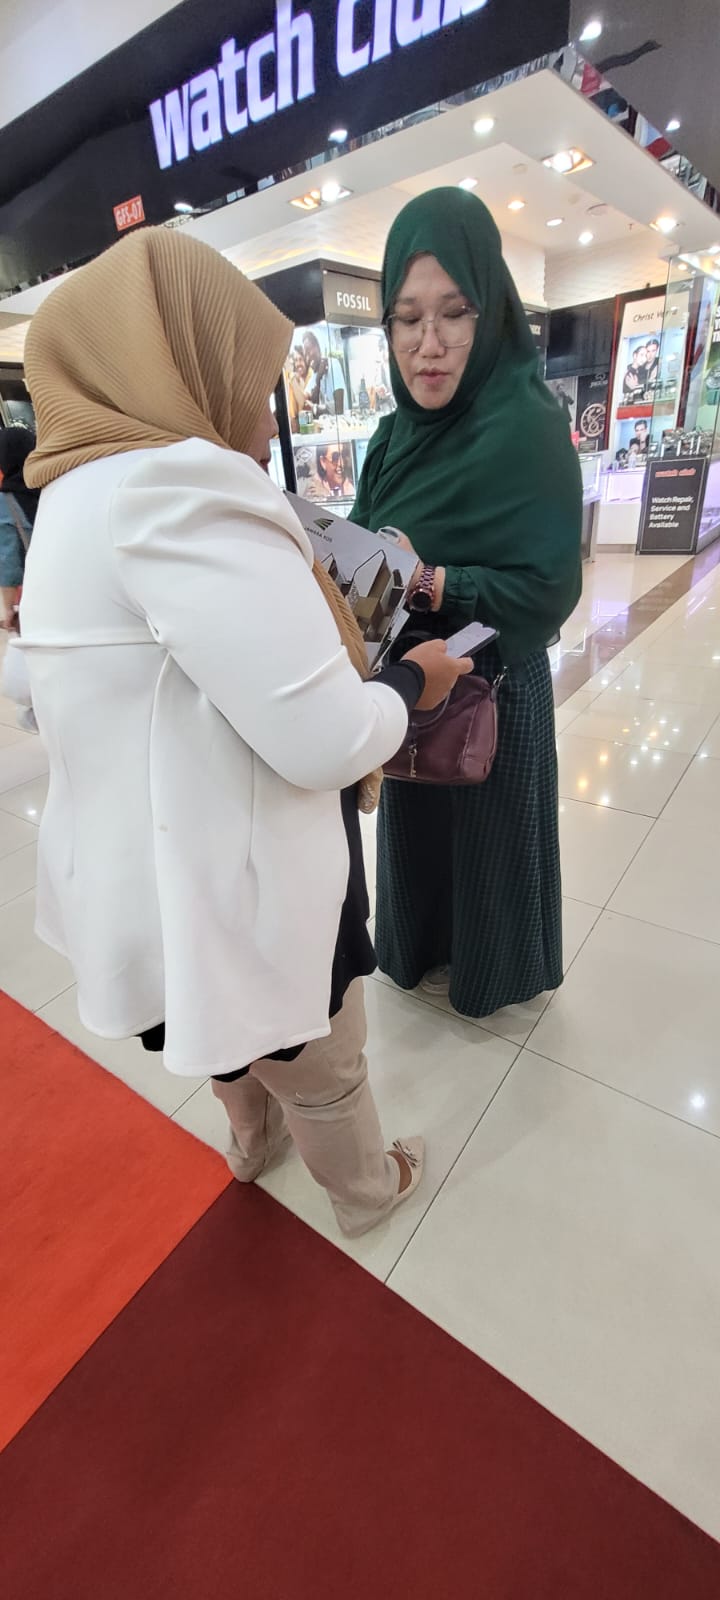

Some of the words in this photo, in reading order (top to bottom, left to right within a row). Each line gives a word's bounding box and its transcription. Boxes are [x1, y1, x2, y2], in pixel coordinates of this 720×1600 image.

[149, 0, 315, 170] watch
[336, 0, 489, 77] clu
[336, 291, 372, 311] FOSSIL
[651, 496, 672, 504] Watch
[649, 513, 675, 521] Battery
